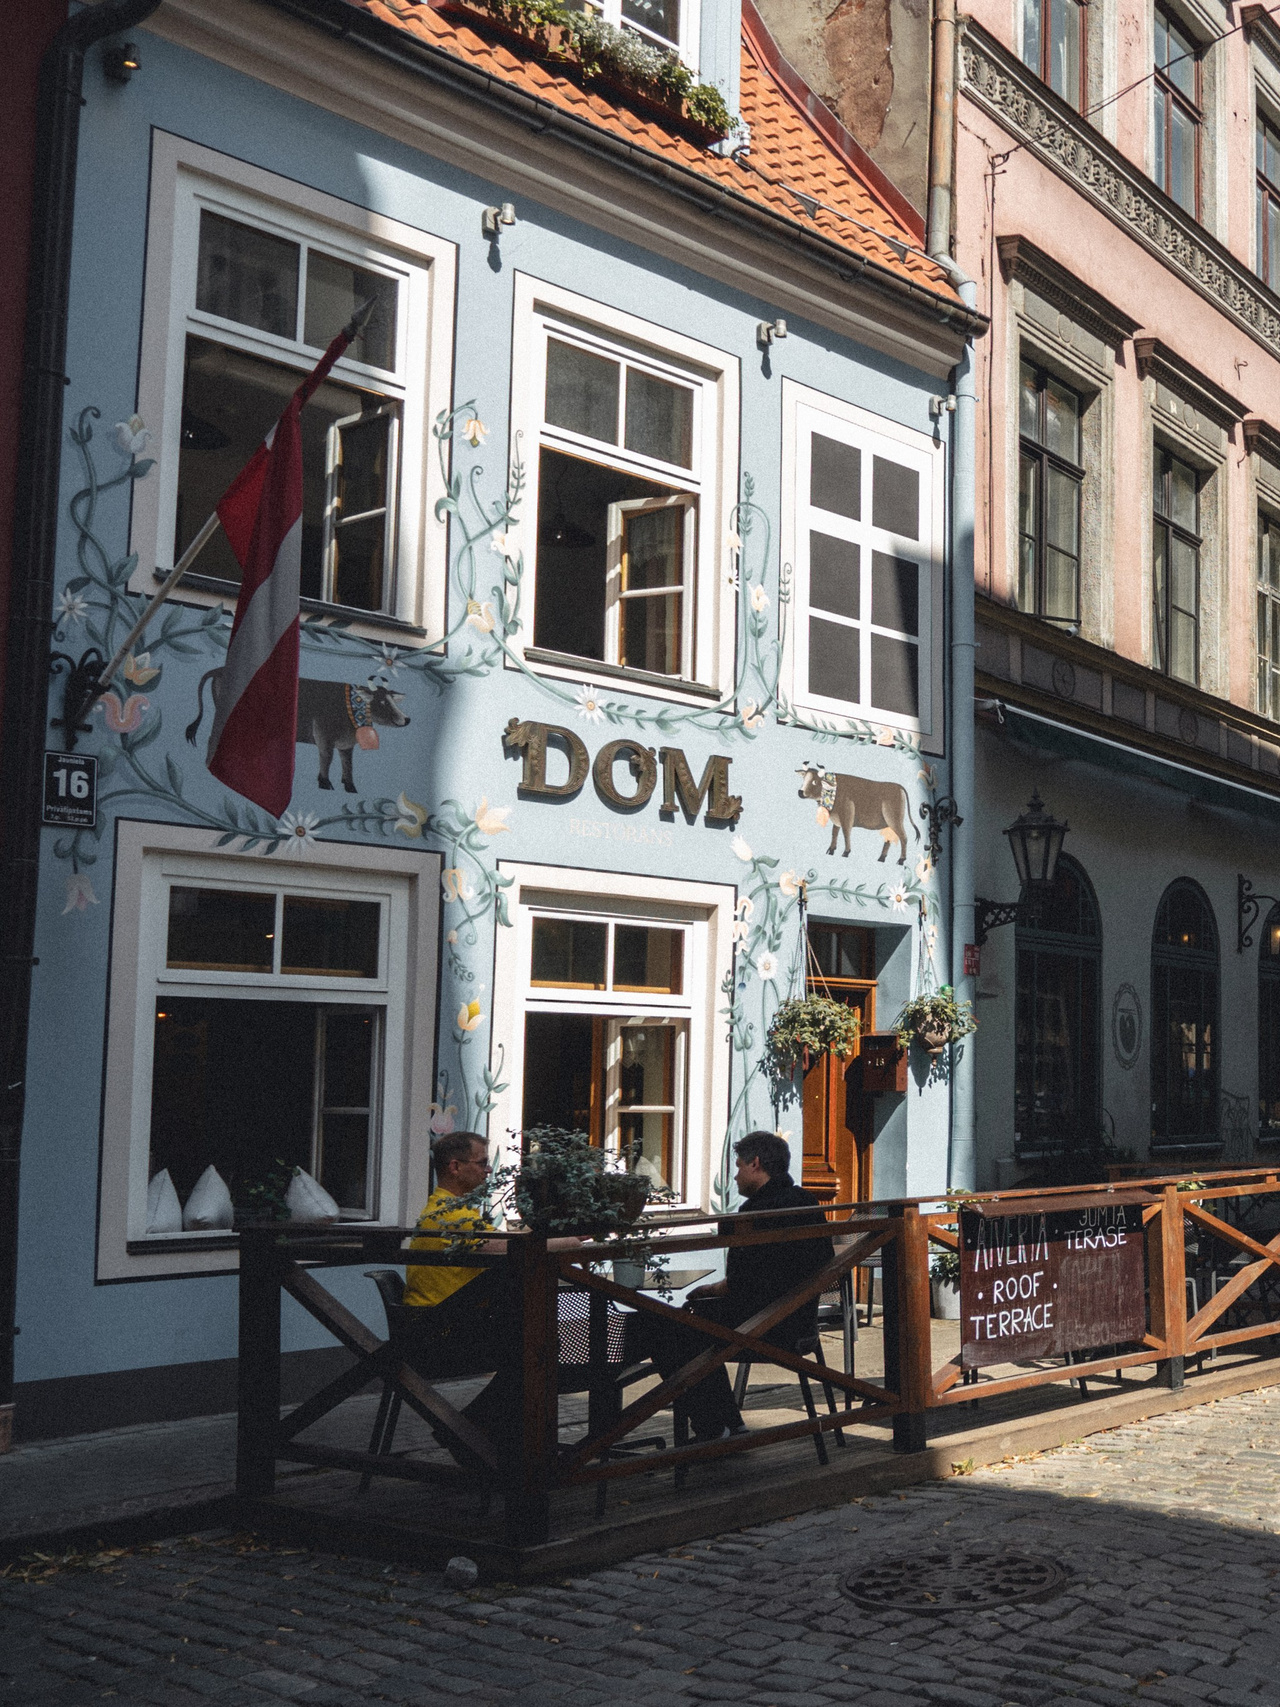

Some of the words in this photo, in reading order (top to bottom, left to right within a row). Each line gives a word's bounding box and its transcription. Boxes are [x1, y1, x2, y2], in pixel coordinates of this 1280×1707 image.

[53, 768, 89, 799] 16
[504, 717, 744, 822] DOM
[569, 818, 673, 847] RESTORANS
[1064, 1226, 1128, 1250] TERASE
[993, 1271, 1045, 1305] ROOF
[969, 1303, 1054, 1340] TERRACE
